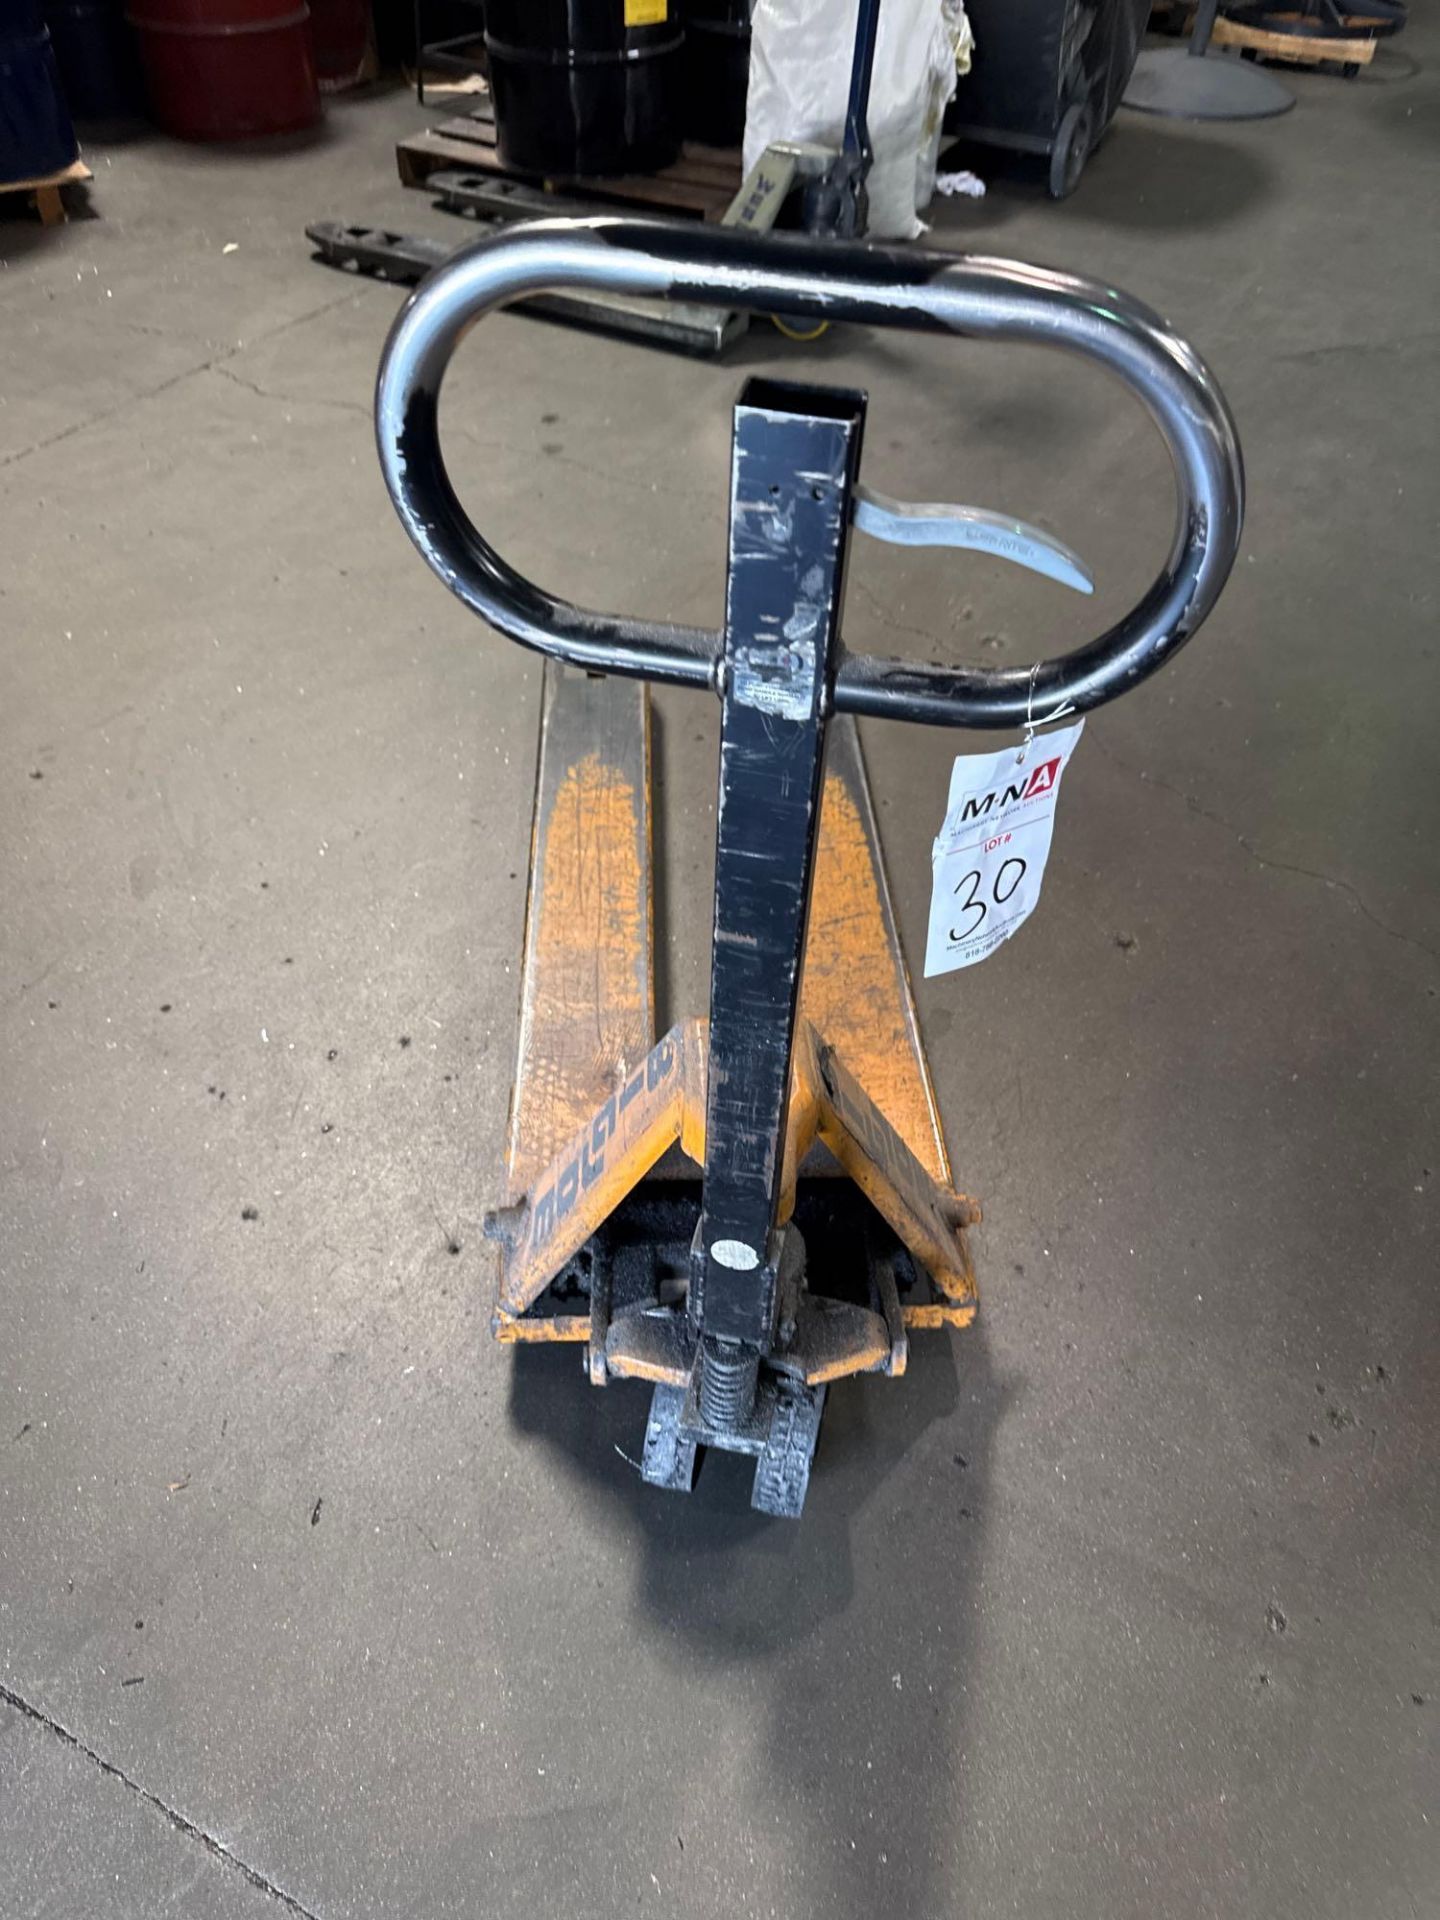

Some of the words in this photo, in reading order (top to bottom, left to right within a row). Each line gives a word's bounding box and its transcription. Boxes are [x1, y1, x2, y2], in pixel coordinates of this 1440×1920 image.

[984, 836, 1004, 854] LOT
[1004, 832, 1013, 845] #
[949, 857, 1027, 942] 30
